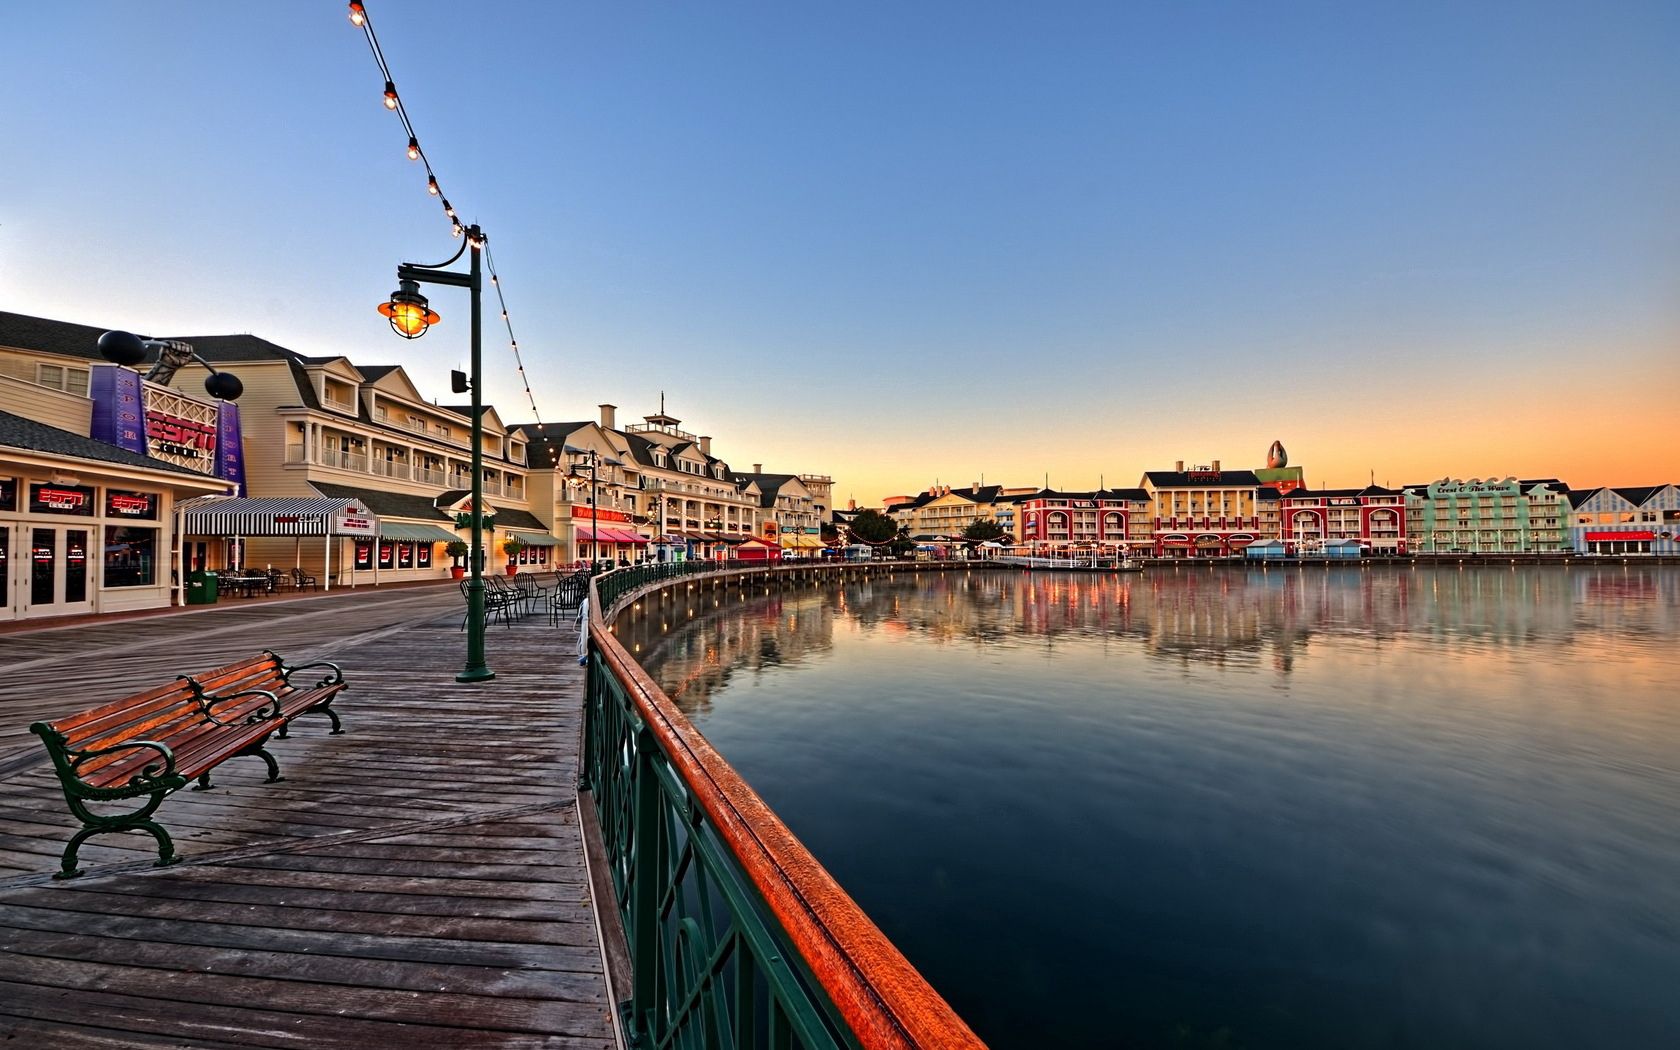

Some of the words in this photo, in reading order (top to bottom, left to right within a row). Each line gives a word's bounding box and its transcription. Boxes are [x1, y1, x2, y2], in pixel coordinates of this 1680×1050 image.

[146, 410, 216, 450] ESPN
[39, 488, 83, 506] ESPN
[112, 495, 149, 511] ESPN
